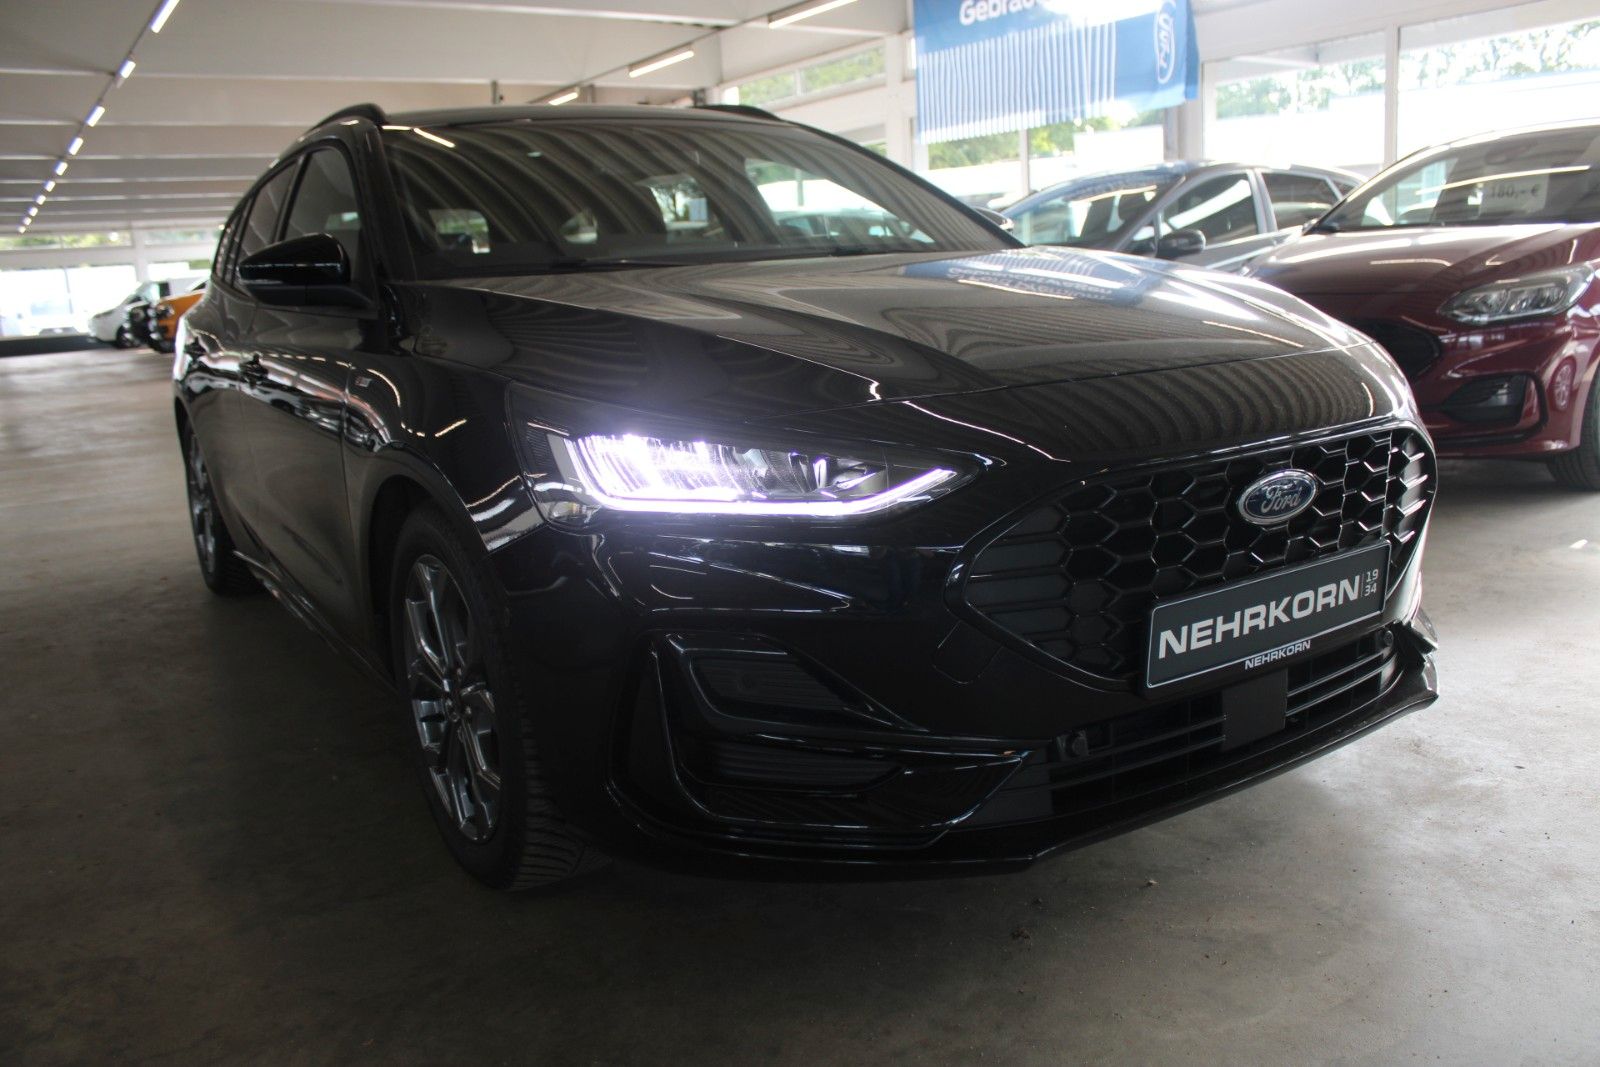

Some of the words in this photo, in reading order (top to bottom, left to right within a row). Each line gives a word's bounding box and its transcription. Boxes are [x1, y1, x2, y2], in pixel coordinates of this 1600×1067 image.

[1262, 480, 1303, 513] Ford
[1364, 583, 1378, 597] 34
[1365, 568, 1379, 582] 19
[1159, 575, 1360, 659] NEHRKORN
[1244, 640, 1312, 670] NEHRKORN
